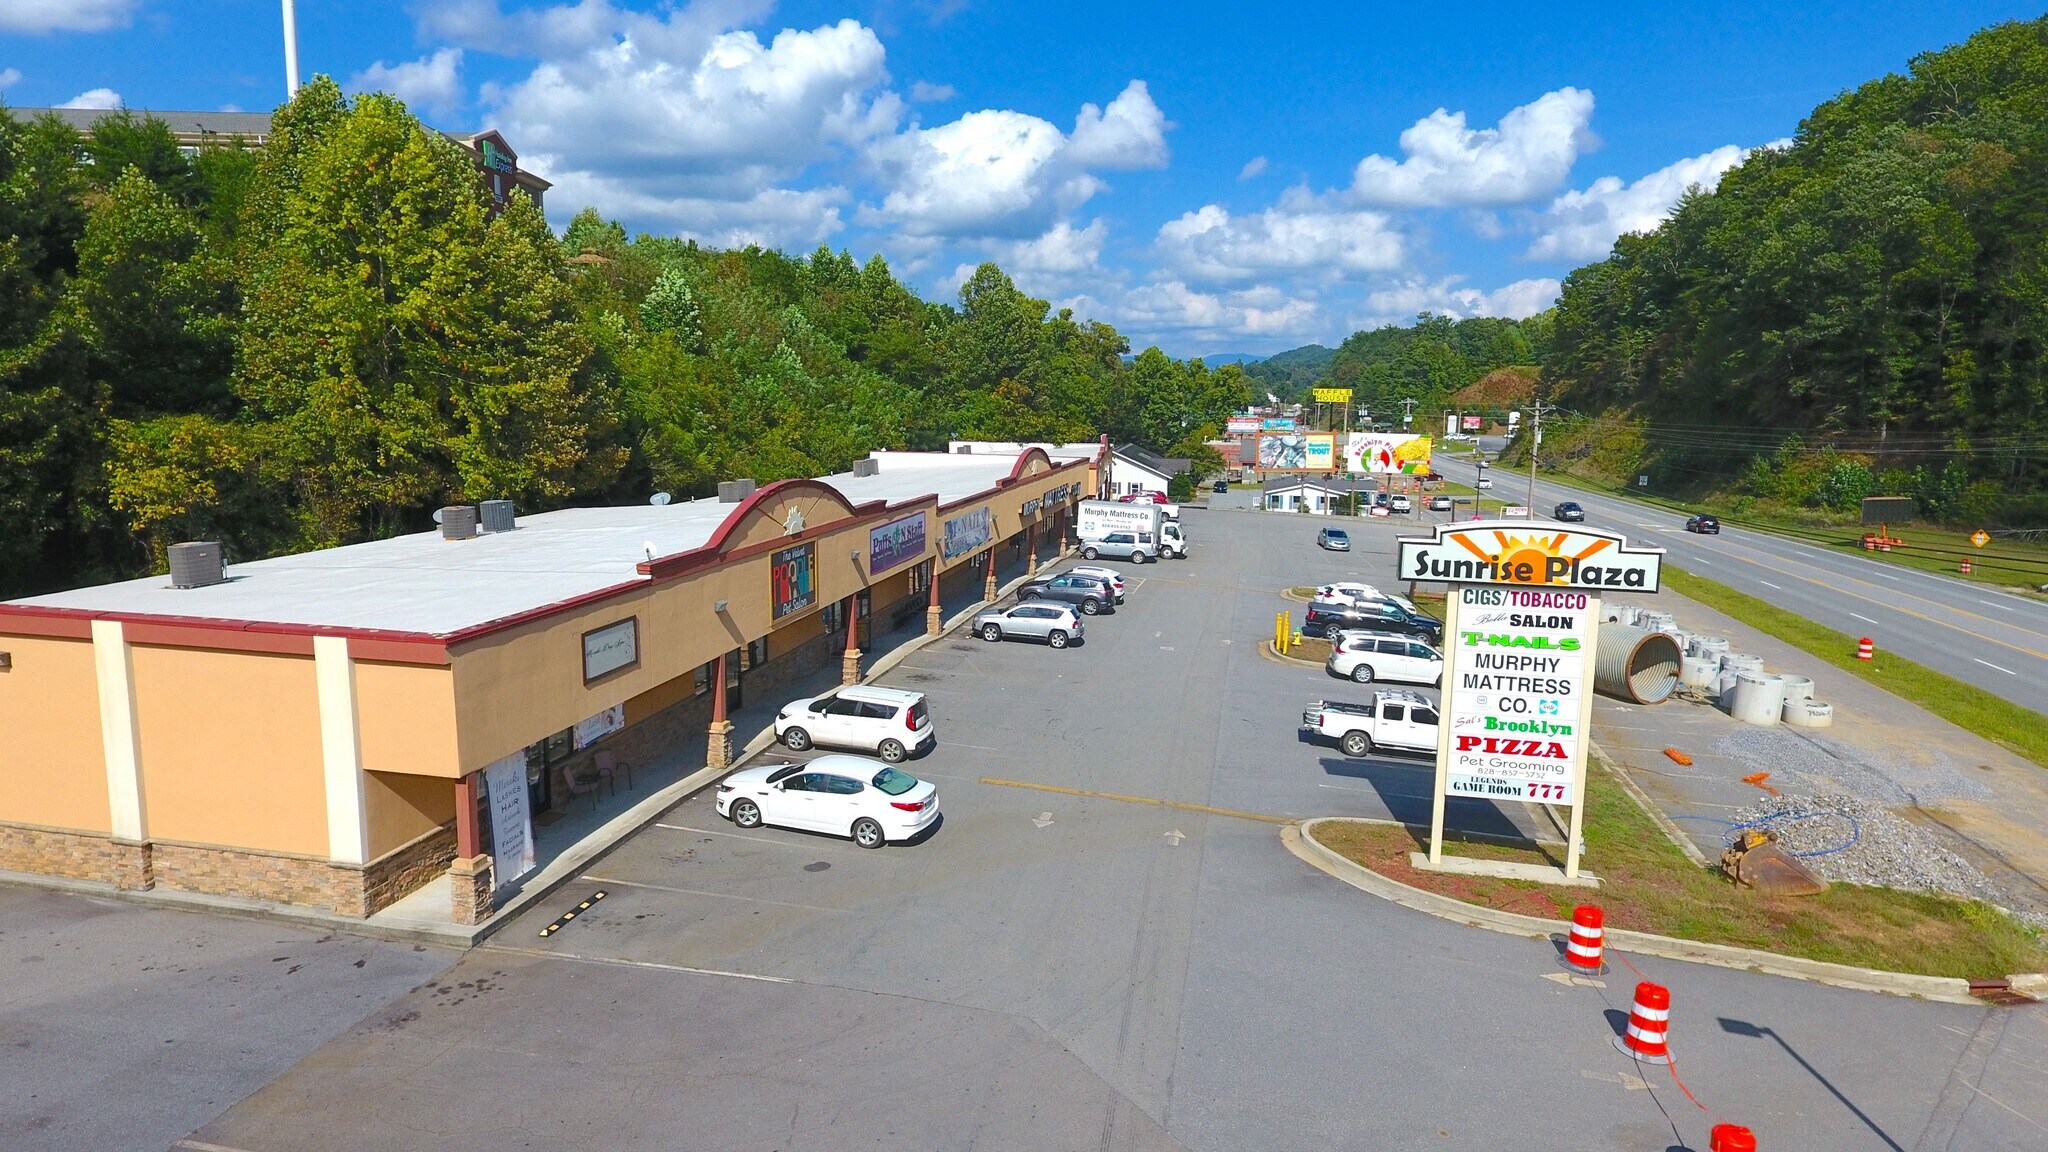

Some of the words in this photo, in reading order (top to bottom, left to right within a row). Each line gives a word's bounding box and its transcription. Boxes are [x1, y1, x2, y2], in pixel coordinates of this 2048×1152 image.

[1308, 447, 1331, 455] TROUT
[1354, 439, 1383, 457] Brooklyn
[1084, 507, 1108, 518] Murphy
[1109, 510, 1139, 519] Mattress
[1139, 512, 1151, 520] Co.
[782, 550, 791, 562] The
[1414, 550, 1534, 582] Sunrise
[1545, 556, 1646, 587] Plaza
[773, 553, 814, 608] POODLE
[782, 602, 791, 615] Pet
[792, 597, 808, 612] Salon
[1463, 589, 1587, 610] CIGS/TOBACCO
[1510, 614, 1574, 630] SALON
[1461, 631, 1581, 651] T-NAILS
[1475, 653, 1561, 673] MURPHY
[1463, 673, 1571, 696] MATTRESS
[1498, 697, 1532, 714] CO.
[1454, 715, 1481, 728] Sal's
[1484, 716, 1572, 738] Brooklyn
[1456, 735, 1569, 759] PIZZA
[1460, 755, 1485, 766] Pet
[1489, 757, 1565, 775] Grooming
[1477, 767, 1546, 779] 828-837-3732
[1470, 776, 1507, 785] LEGENDS
[497, 785, 522, 803] LASHES
[1453, 781, 1486, 793] GAME
[1488, 785, 1522, 796] ROOM
[1527, 783, 1566, 799] 777
[501, 798, 519, 814] HAIR
[502, 831, 524, 848] FACIALS
